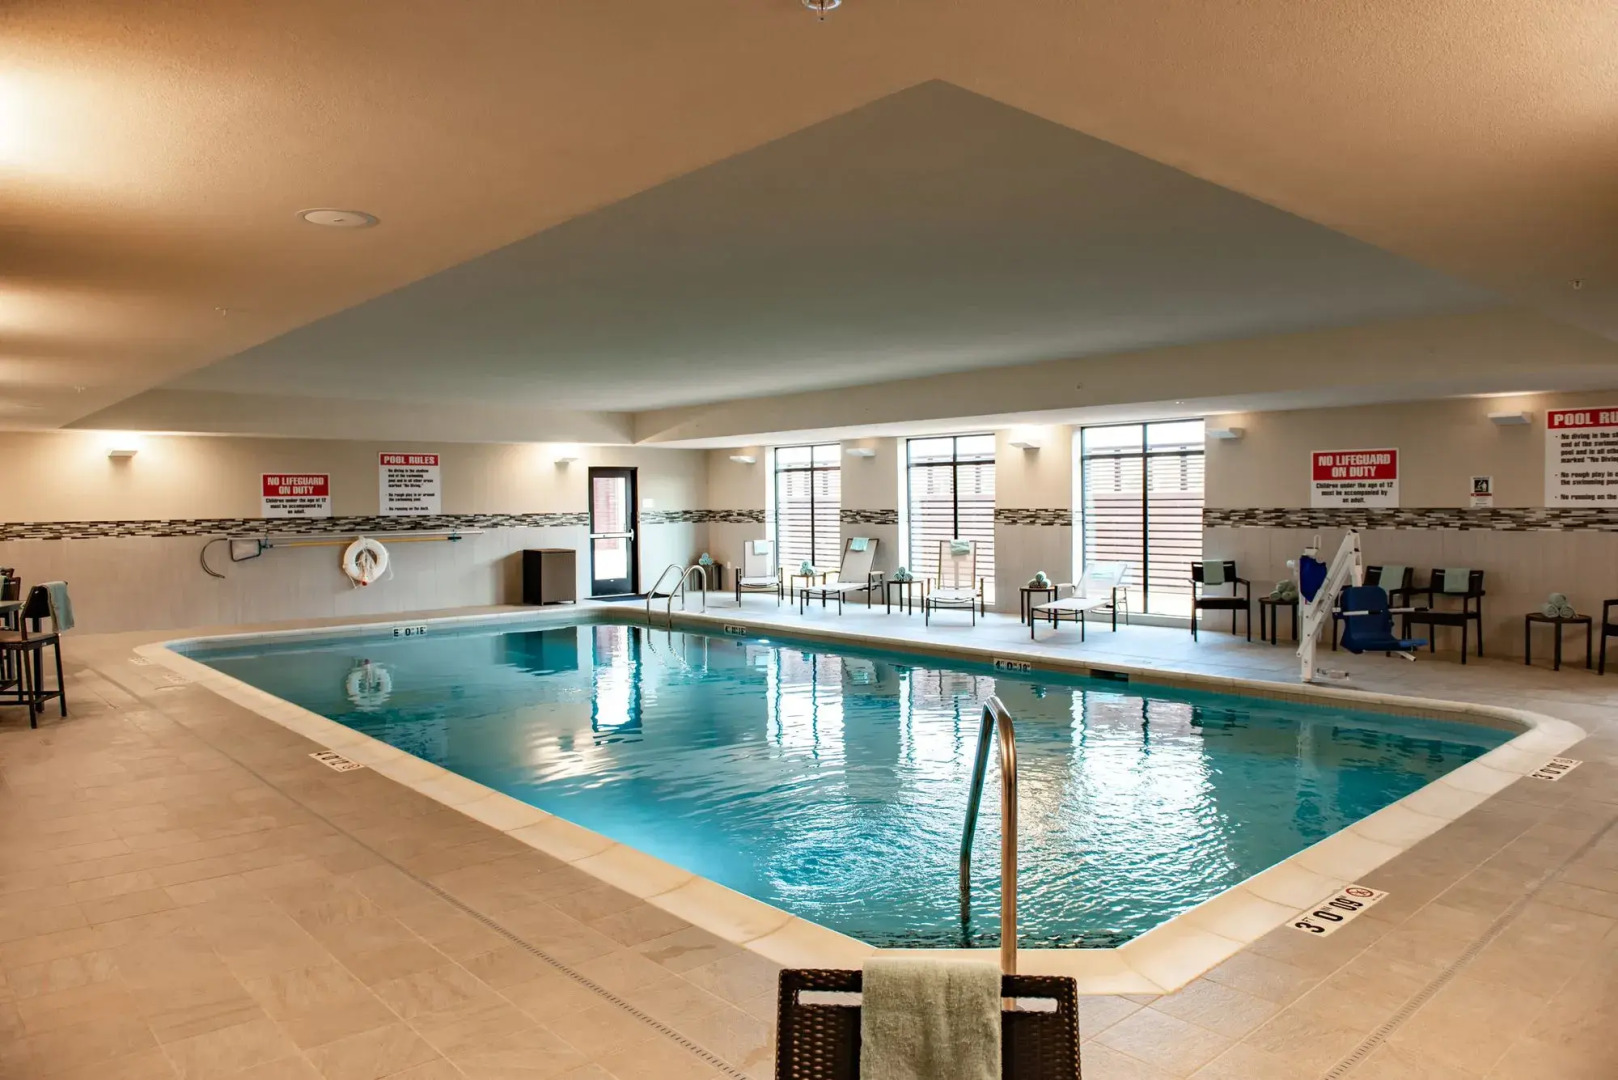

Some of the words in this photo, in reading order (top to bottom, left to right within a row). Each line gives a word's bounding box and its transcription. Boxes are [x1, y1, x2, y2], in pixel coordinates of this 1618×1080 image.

[1554, 412, 1594, 426] POOL
[384, 456, 406, 464] POOL
[409, 456, 435, 464] RULES
[1318, 456, 1333, 466] NO
[1336, 454, 1391, 466] LIFEGUARD
[1332, 467, 1346, 477] ON
[1350, 466, 1376, 477] DUTY
[268, 476, 280, 486] NO
[282, 477, 324, 486] LIFEGUARD
[279, 486, 291, 494] ON
[293, 486, 314, 494] DUTY
[1295, 922, 1325, 933] 3
